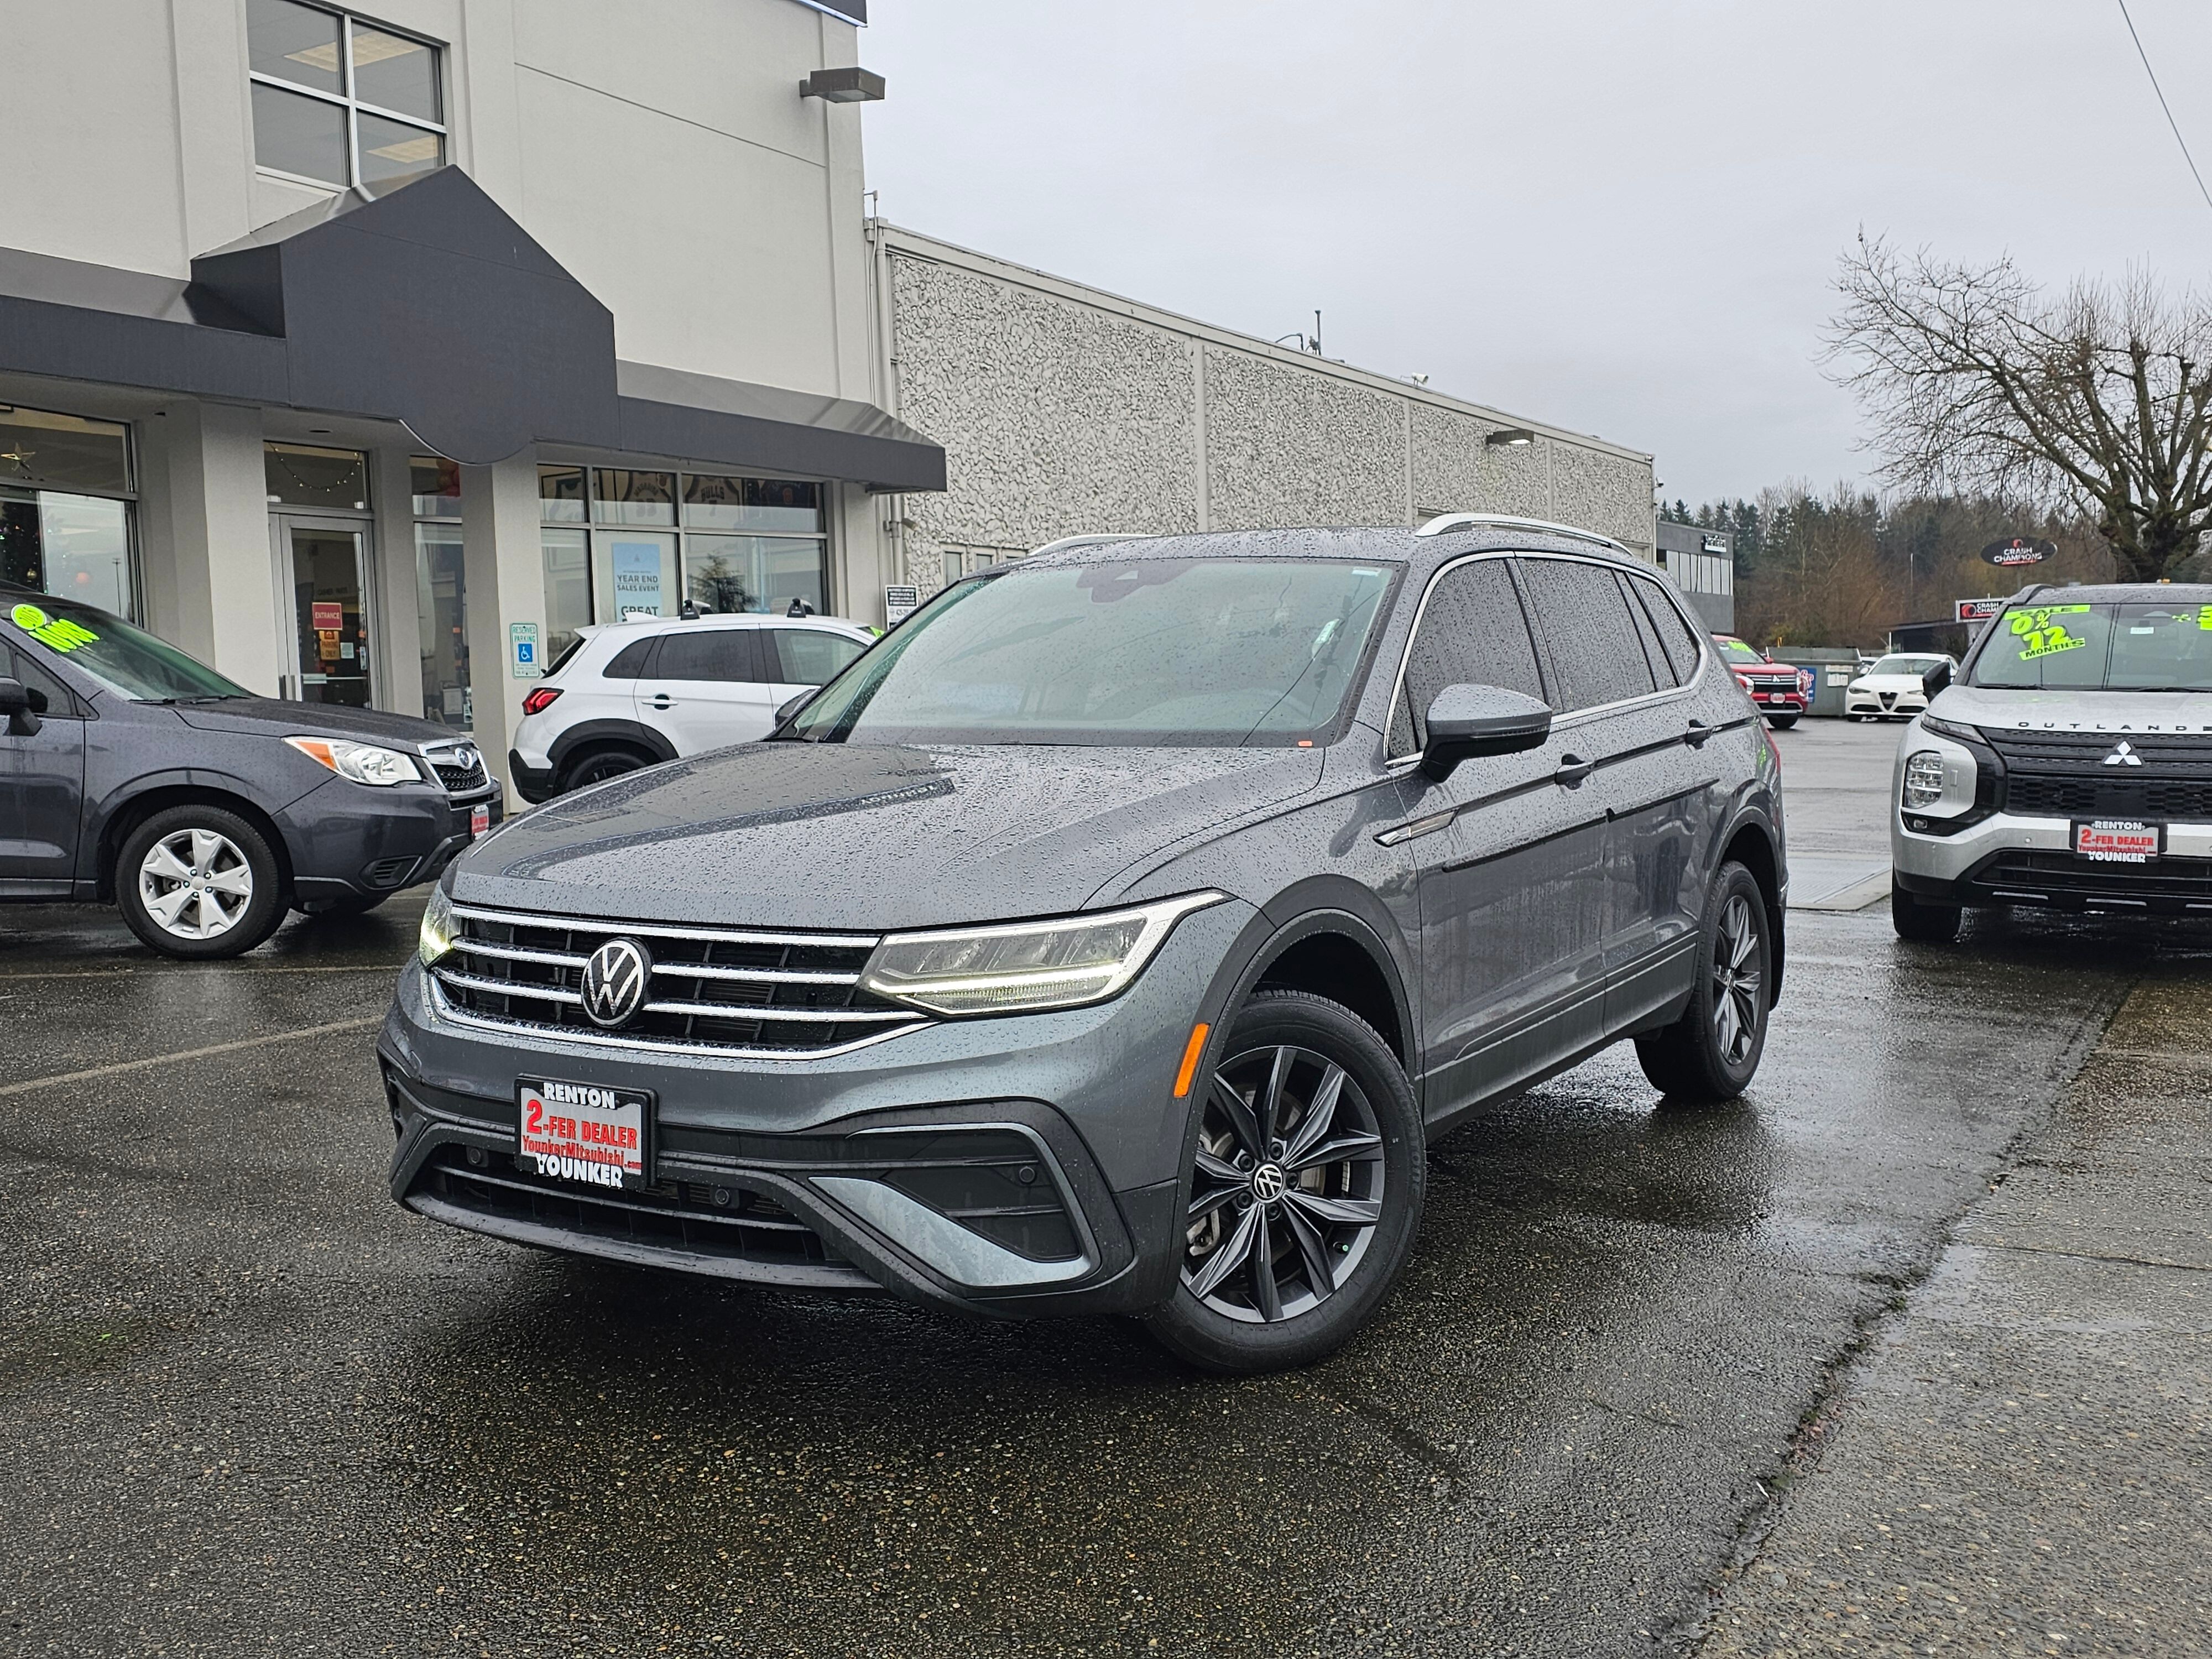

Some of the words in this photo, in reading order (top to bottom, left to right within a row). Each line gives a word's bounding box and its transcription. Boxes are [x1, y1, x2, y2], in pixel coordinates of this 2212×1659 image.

[2004, 546, 2033, 555] CRASH
[1994, 553, 2042, 563] CHAMPIONS
[617, 575, 640, 583] YEAR
[641, 575, 658, 583] END
[314, 611, 340, 620] ENTRANCE
[513, 625, 536, 634] RESERVED
[2011, 613, 2051, 635] 0%
[2025, 639, 2085, 658] MONTHS
[2094, 821, 2142, 831] RENTON
[2081, 828, 2114, 844] 2-FER
[2117, 836, 2154, 846] DEALER
[2088, 851, 2146, 863] YOUNKER
[542, 1082, 615, 1109] RENTON
[526, 1099, 576, 1140] 2-FER
[581, 1120, 638, 1150] DEALER
[535, 1152, 623, 1188] YOUNKER
